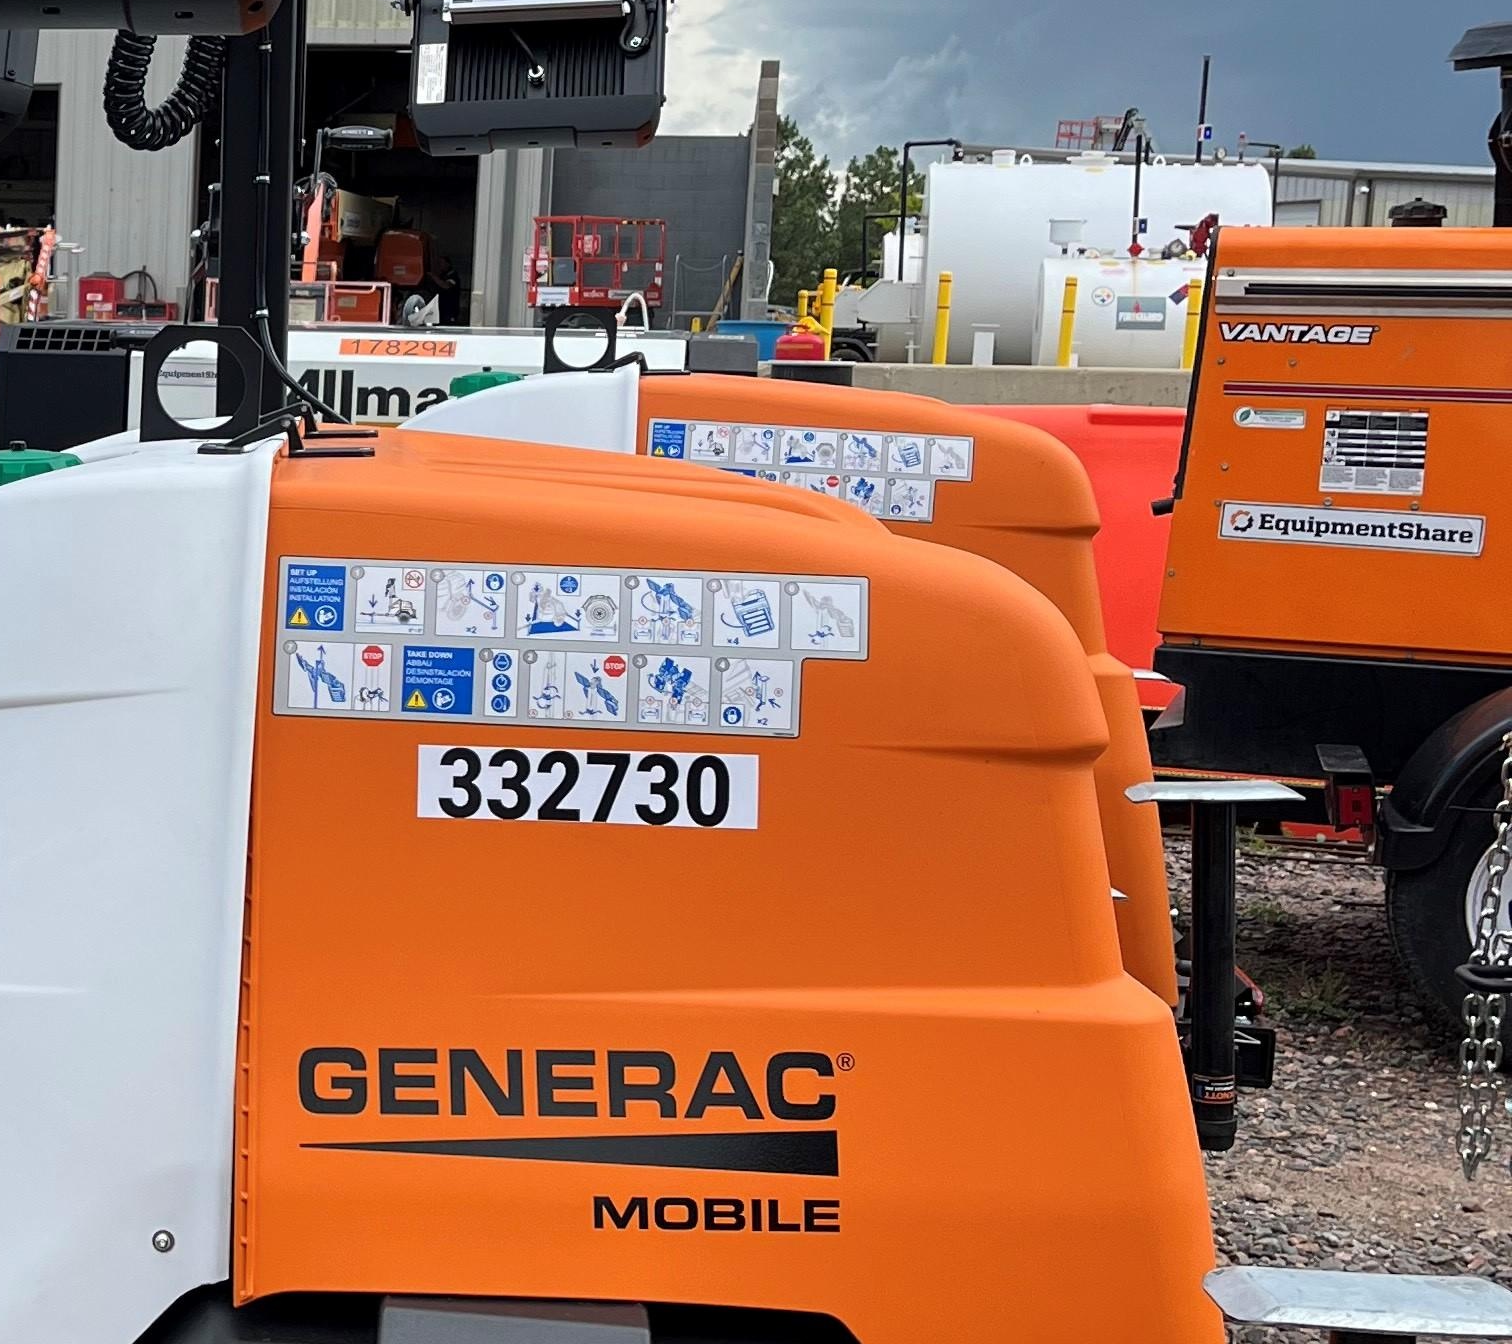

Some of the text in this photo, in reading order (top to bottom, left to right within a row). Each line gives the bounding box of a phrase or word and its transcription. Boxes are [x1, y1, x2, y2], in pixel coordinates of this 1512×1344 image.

[1219, 322, 1373, 345] VANTAGE
[352, 339, 455, 356] 178294
[1258, 513, 1474, 545] EquipmentShare
[289, 577, 344, 586] AUFSTELLUNG
[289, 594, 340, 603] INSTALLATION
[362, 652, 383, 661] STOP
[407, 650, 453, 659] TAKE DOWN
[406, 659, 433, 668] ABBAU
[605, 662, 625, 671] STOP
[438, 746, 729, 827] 332730
[593, 1196, 840, 1233] MOBILE
